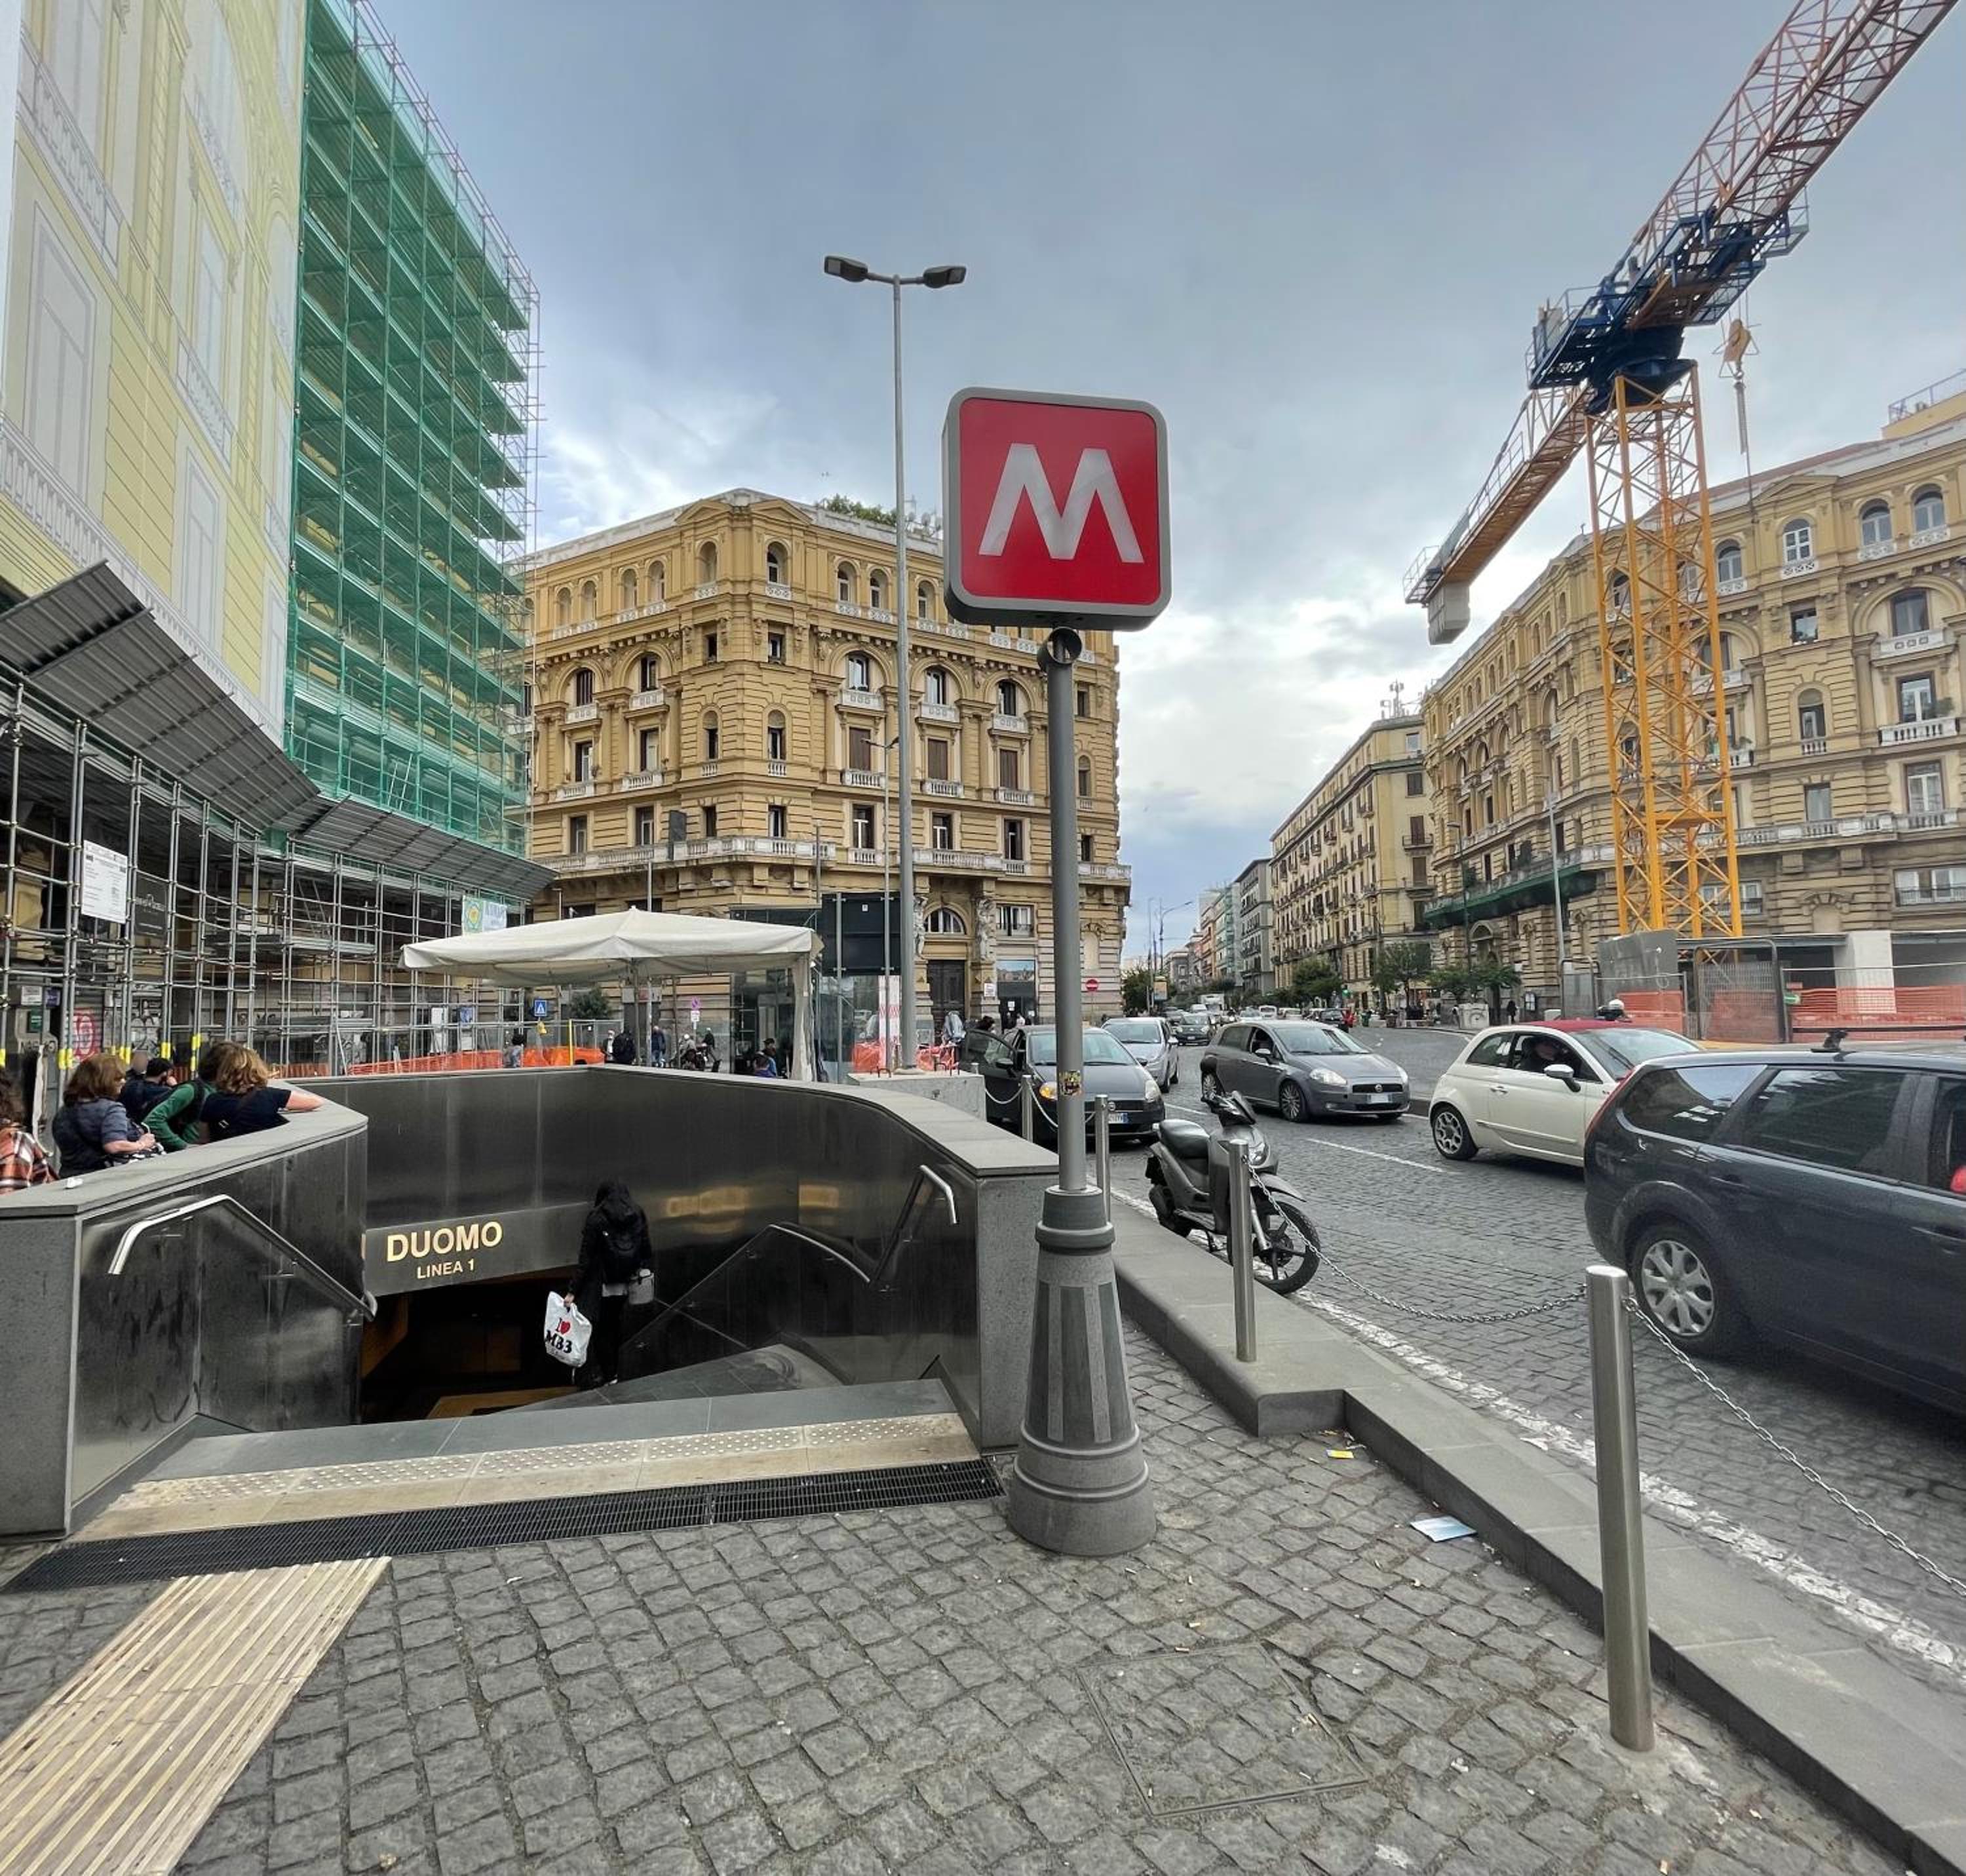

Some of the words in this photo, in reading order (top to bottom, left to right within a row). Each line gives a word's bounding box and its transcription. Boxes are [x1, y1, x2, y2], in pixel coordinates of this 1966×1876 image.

[978, 442, 1144, 563] M
[387, 1221, 503, 1262] DUOMO
[417, 1260, 463, 1279] LINEA
[468, 1259, 474, 1271] 1
